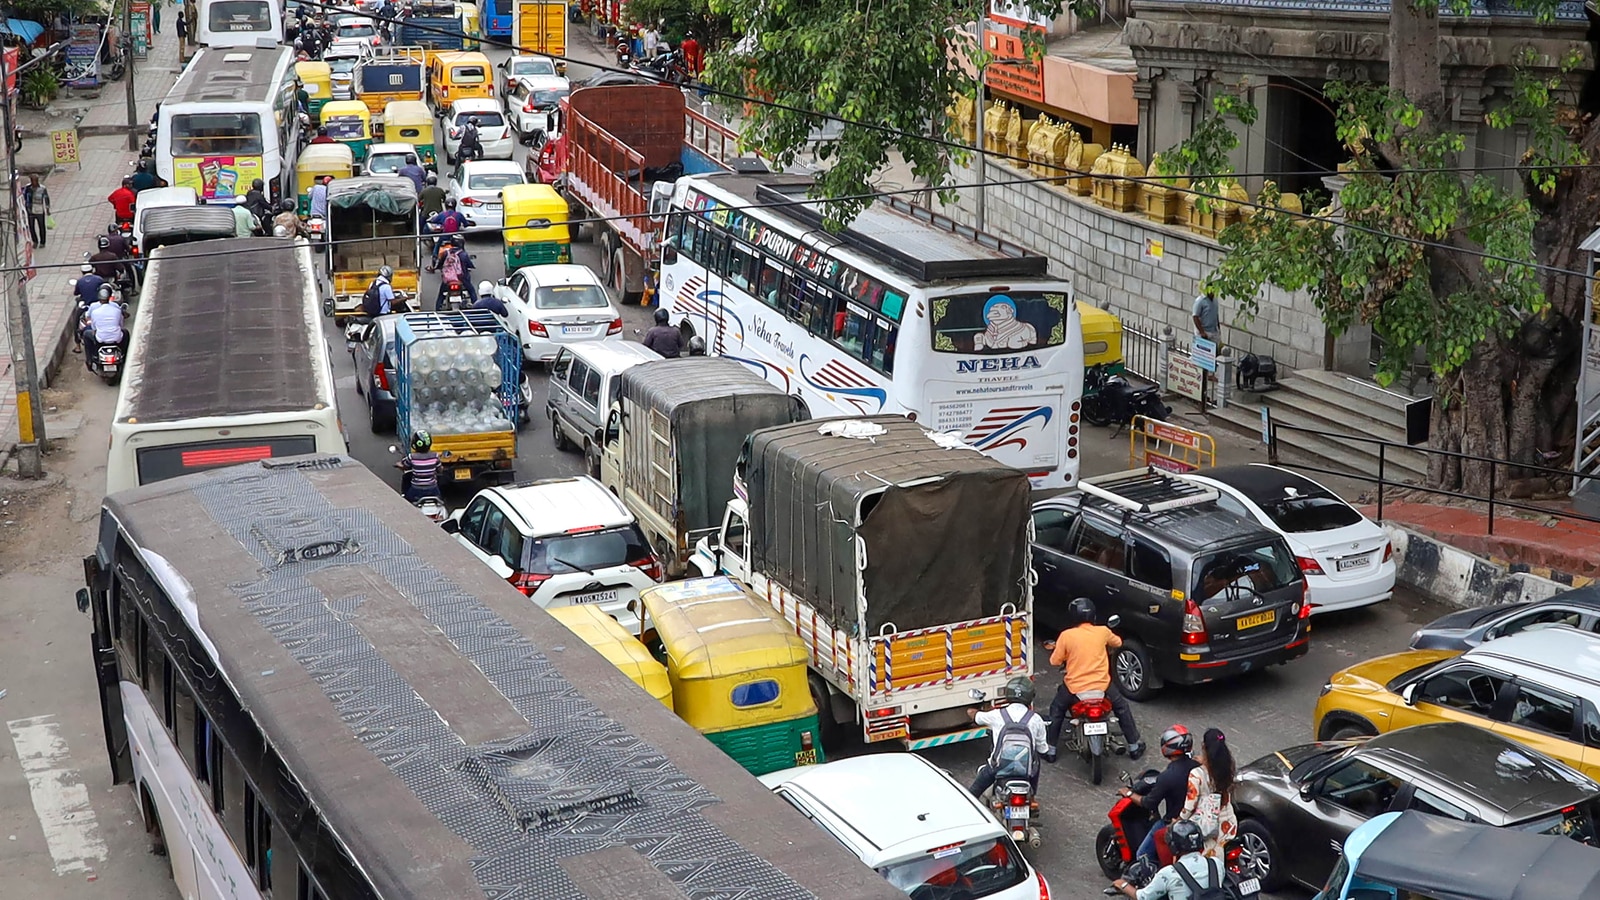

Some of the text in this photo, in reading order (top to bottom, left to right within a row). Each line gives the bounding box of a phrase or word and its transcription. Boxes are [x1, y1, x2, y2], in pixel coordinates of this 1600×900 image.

[755, 225, 797, 261] JOURNY
[748, 314, 772, 344] Neha
[956, 355, 1042, 374] NEHA
[872, 730, 902, 741] STOP
